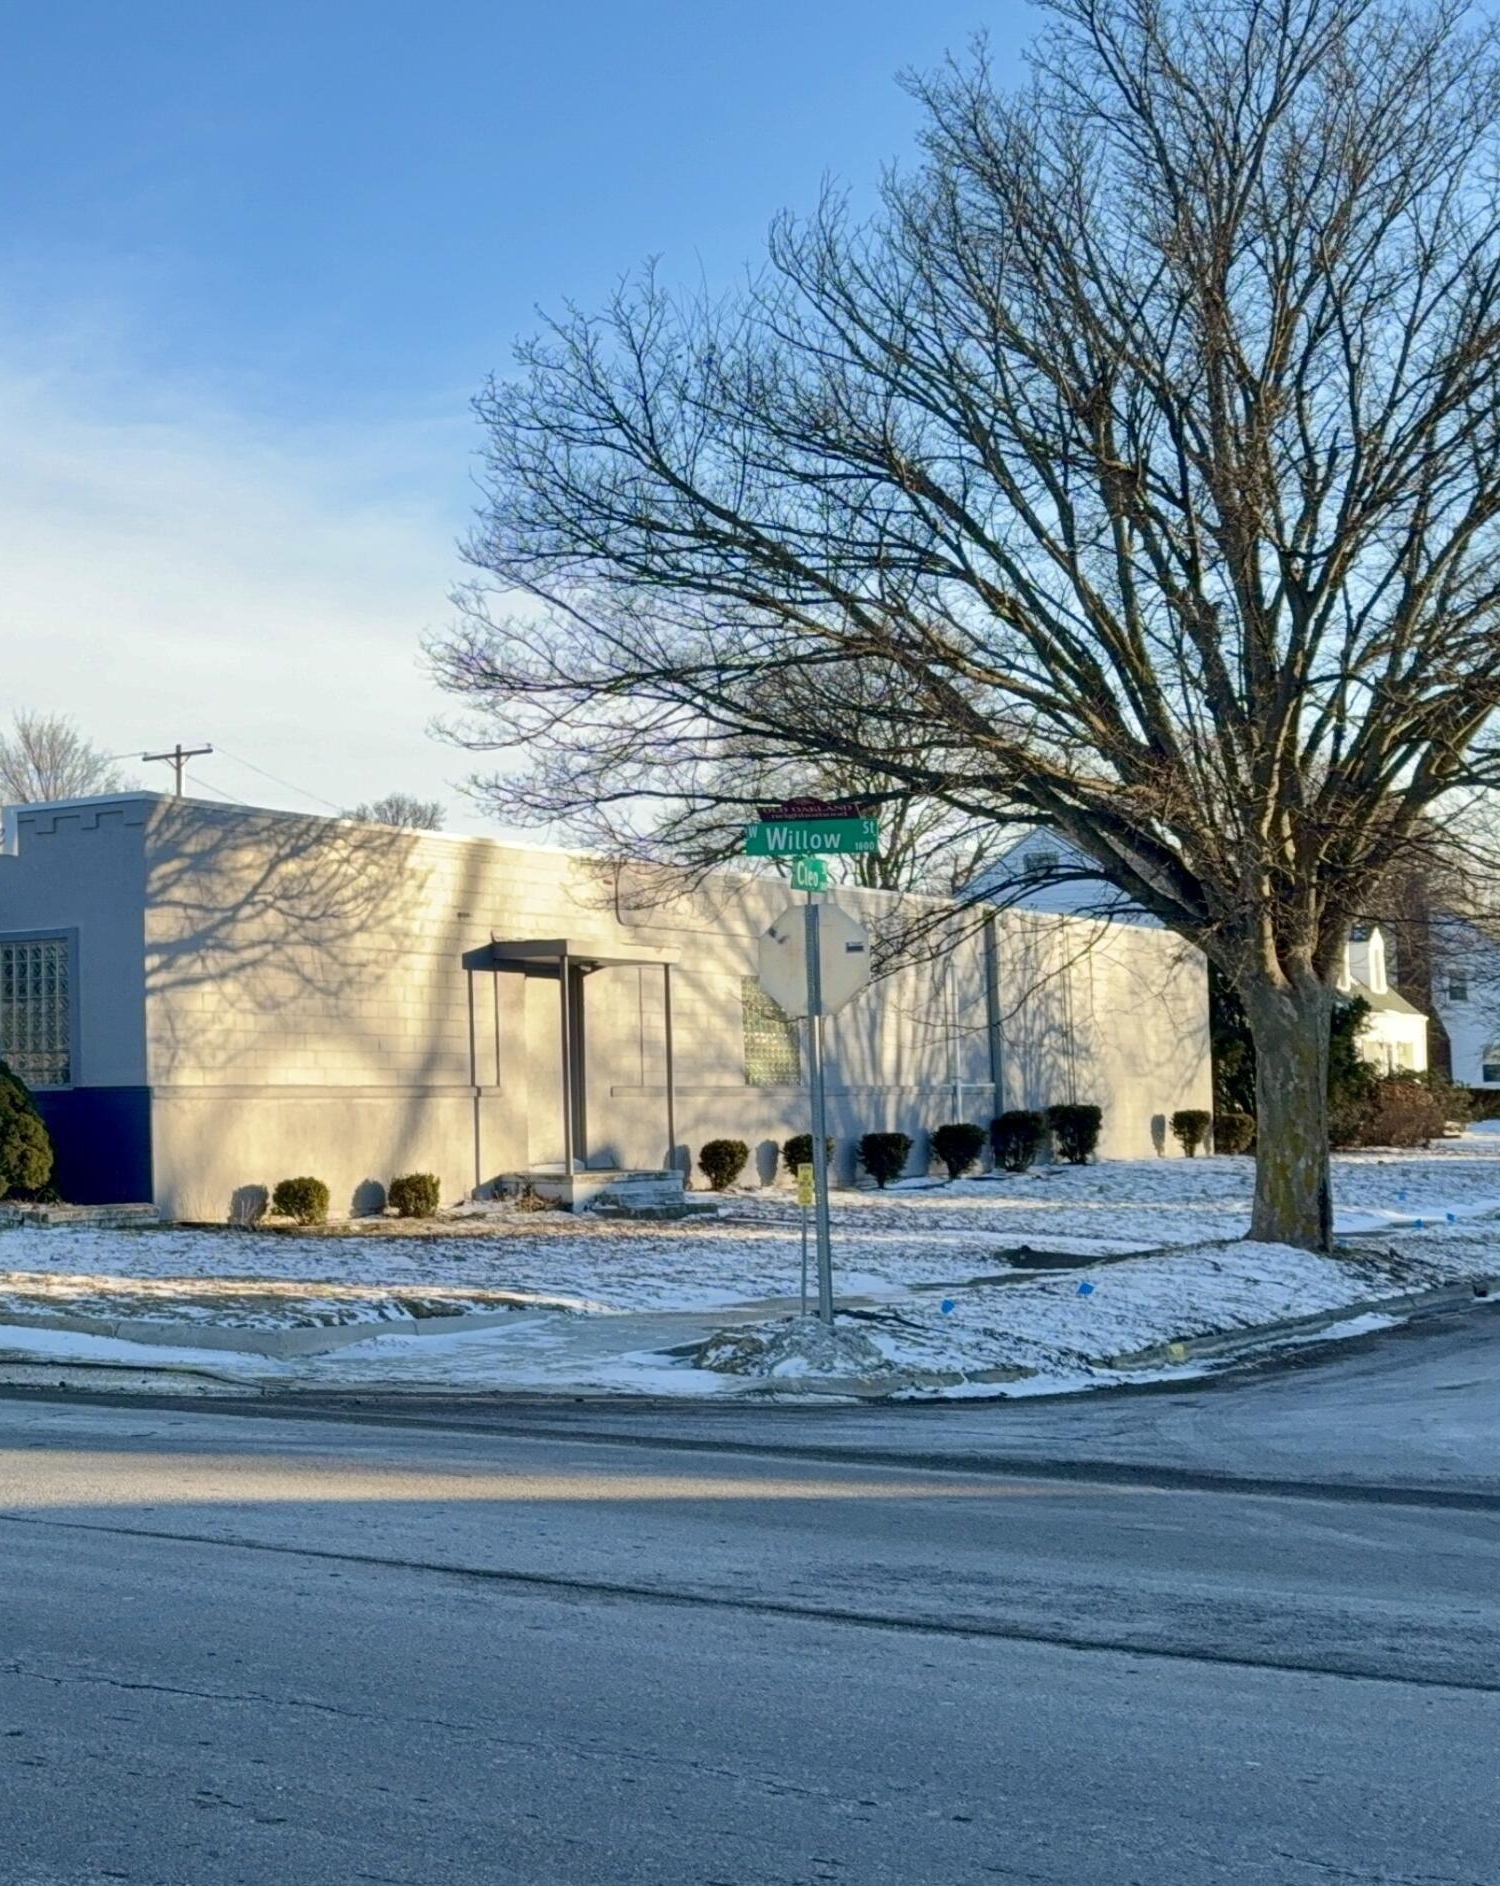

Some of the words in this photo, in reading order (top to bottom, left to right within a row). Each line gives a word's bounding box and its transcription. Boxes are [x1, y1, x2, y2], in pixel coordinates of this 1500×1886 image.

[748, 825, 758, 838] W
[766, 827, 841, 850] Willow
[855, 842, 875, 850] 1800
[798, 861, 818, 887] Cleo
